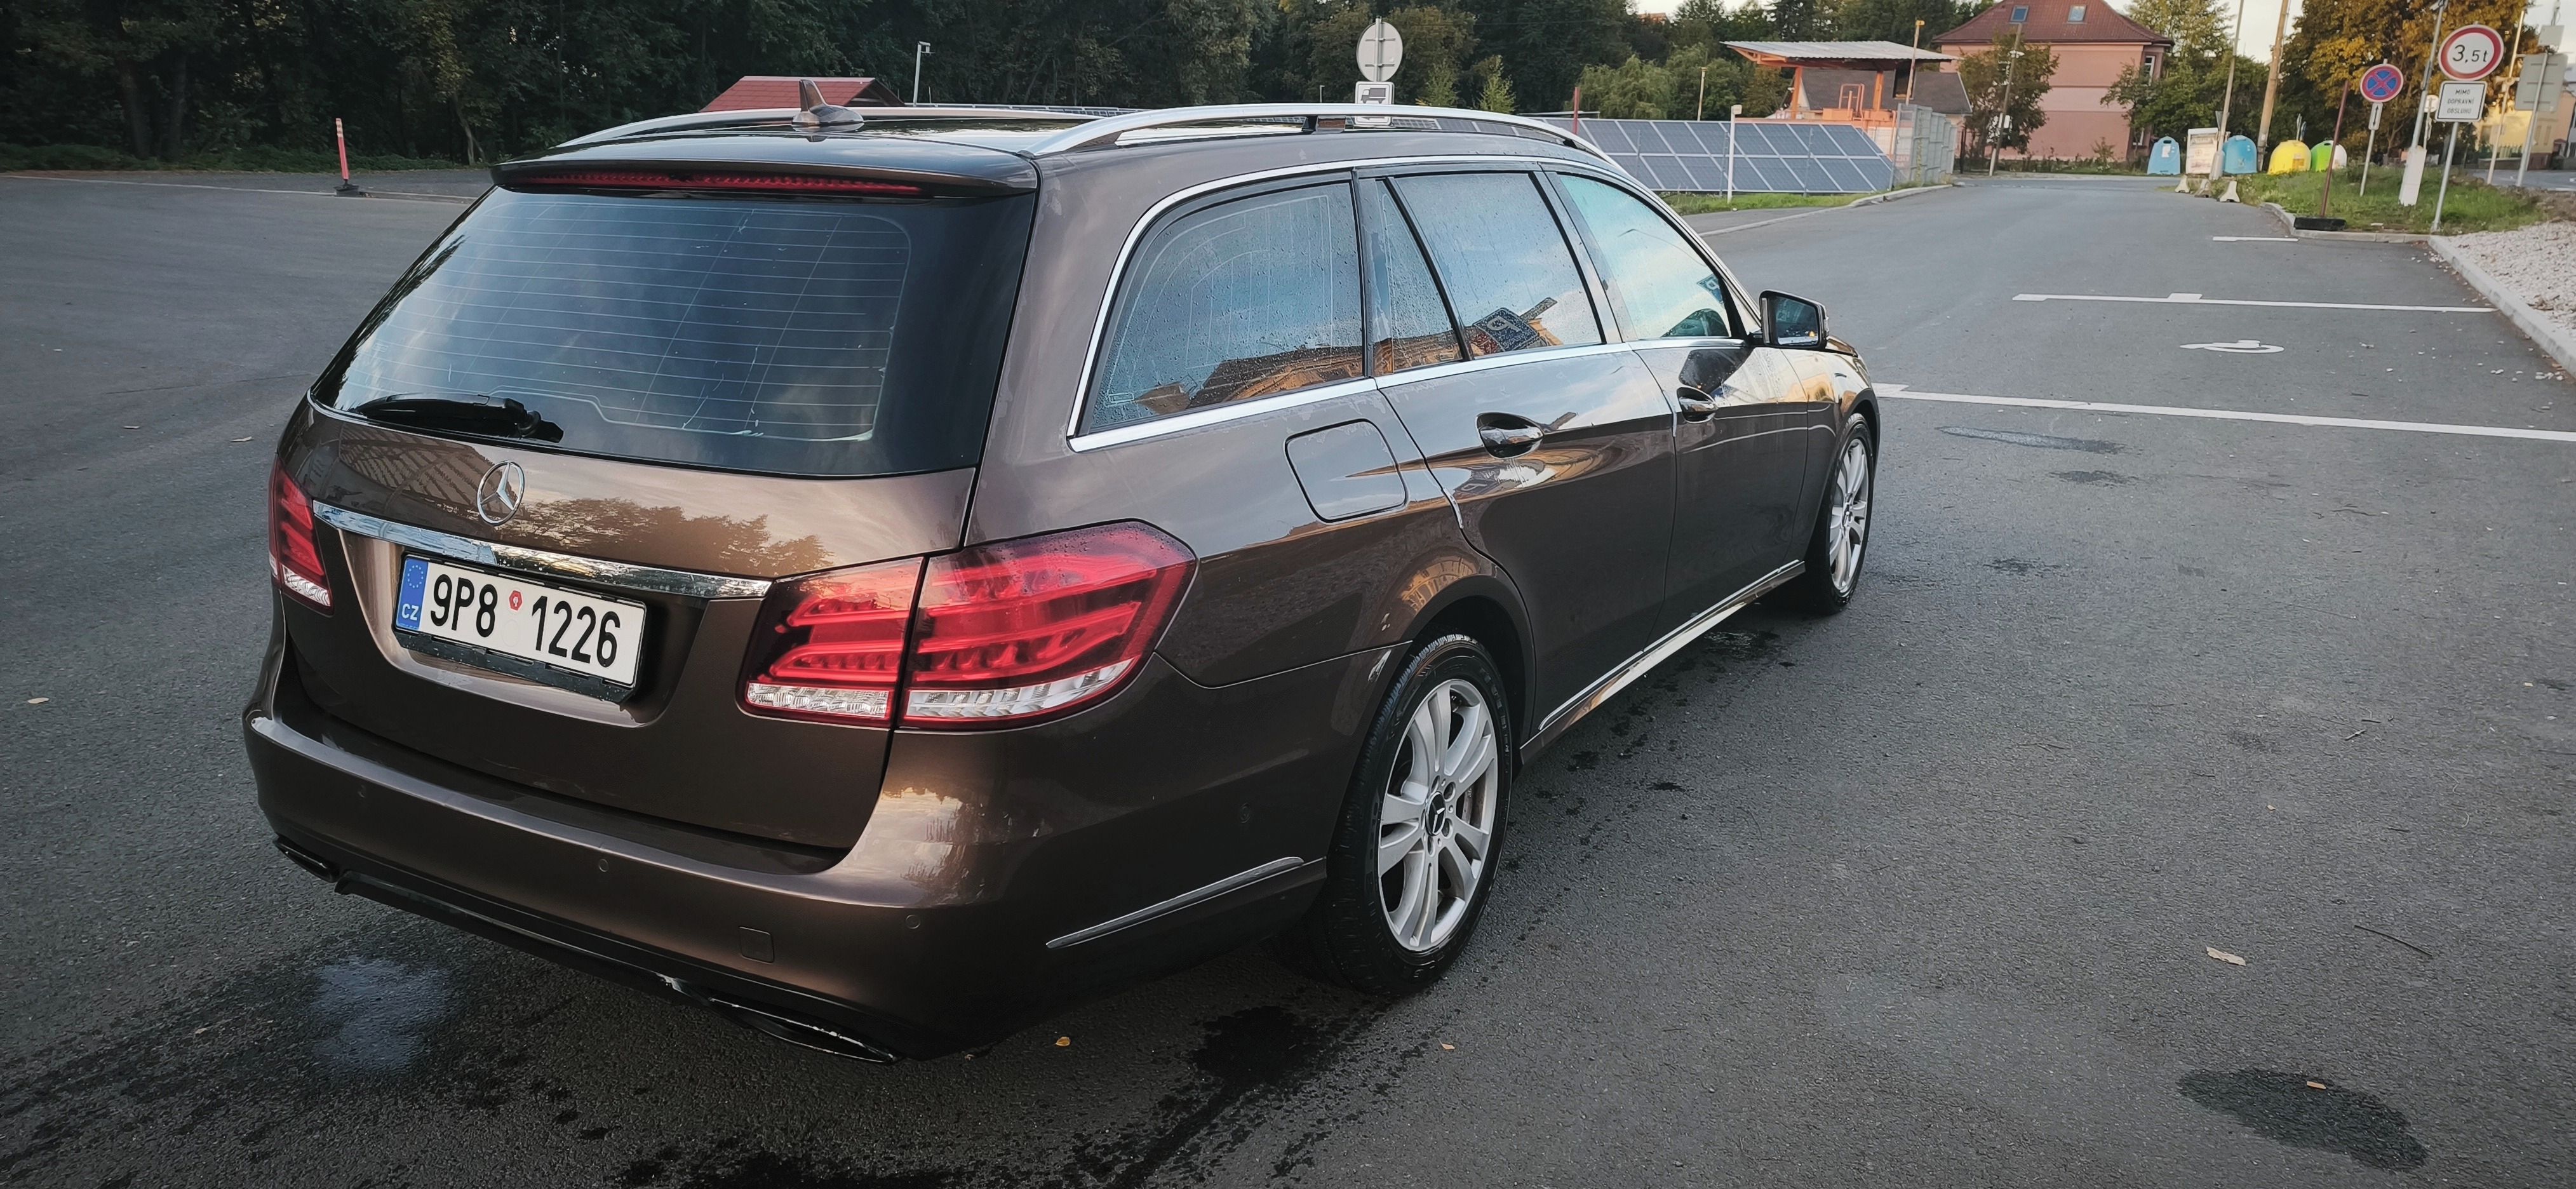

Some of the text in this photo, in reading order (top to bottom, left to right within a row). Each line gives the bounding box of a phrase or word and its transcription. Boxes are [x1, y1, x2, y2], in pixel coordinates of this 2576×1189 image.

[401, 603, 419, 621] CZ
[430, 574, 621, 668] 9P8 1226
